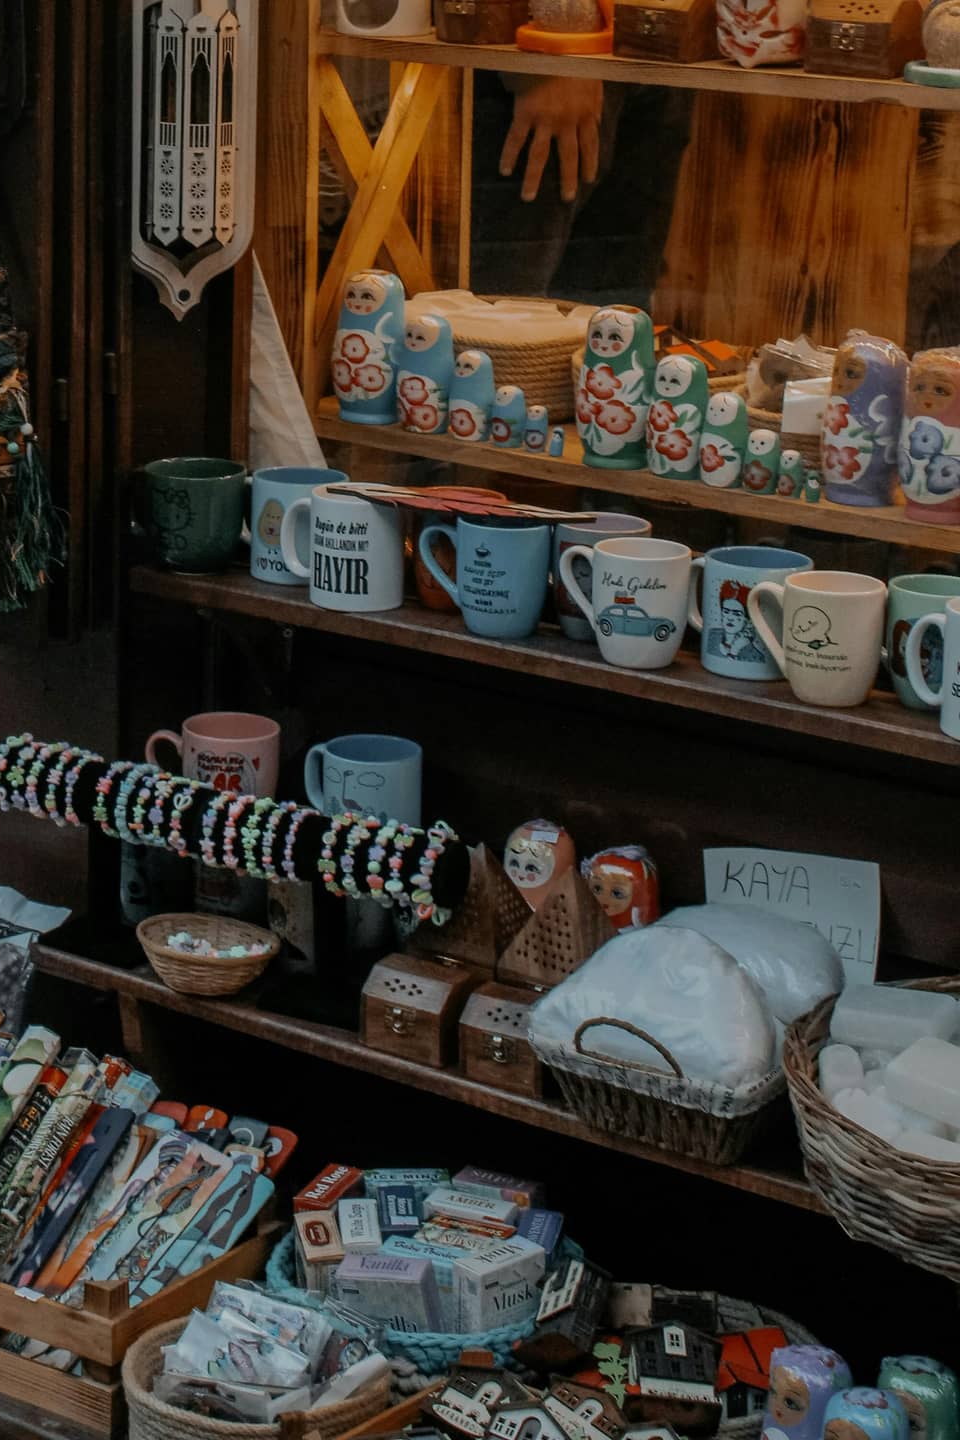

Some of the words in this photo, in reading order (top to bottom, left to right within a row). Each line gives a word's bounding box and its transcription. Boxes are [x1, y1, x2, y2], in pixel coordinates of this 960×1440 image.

[336, 521, 347, 535] de
[348, 521, 369, 536] bitti
[313, 550, 369, 595] HAYIR
[722, 860, 811, 906] KAYA
[53, 1114, 75, 1139] RAIN
[38, 1133, 67, 1171] FOREST
[304, 1181, 327, 1200] Red
[325, 1164, 350, 1186] Rose
[373, 1173, 395, 1181] ICE
[402, 1172, 443, 1184] MINT
[447, 1193, 497, 1211] AMBER
[360, 1255, 412, 1273] Vanilla
[476, 1242, 525, 1264] Musk
[491, 1282, 534, 1312] Musk
